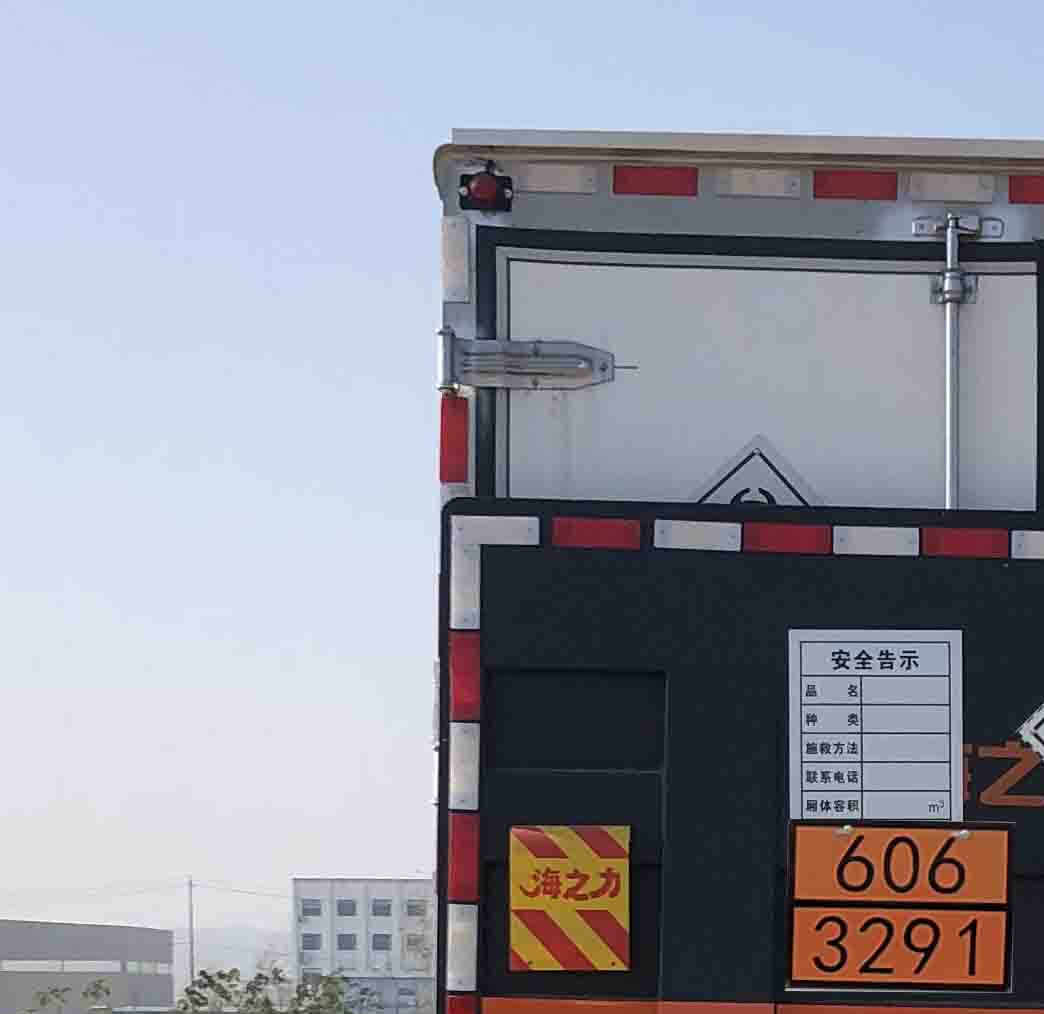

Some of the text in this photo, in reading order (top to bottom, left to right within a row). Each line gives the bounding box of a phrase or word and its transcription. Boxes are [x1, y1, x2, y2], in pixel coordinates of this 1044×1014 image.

[830, 649, 920, 671] 安全告示
[806, 770, 859, 784] 联系电话
[835, 834, 966, 894] 606
[519, 866, 621, 901] 海之力
[812, 915, 978, 977] 3291
